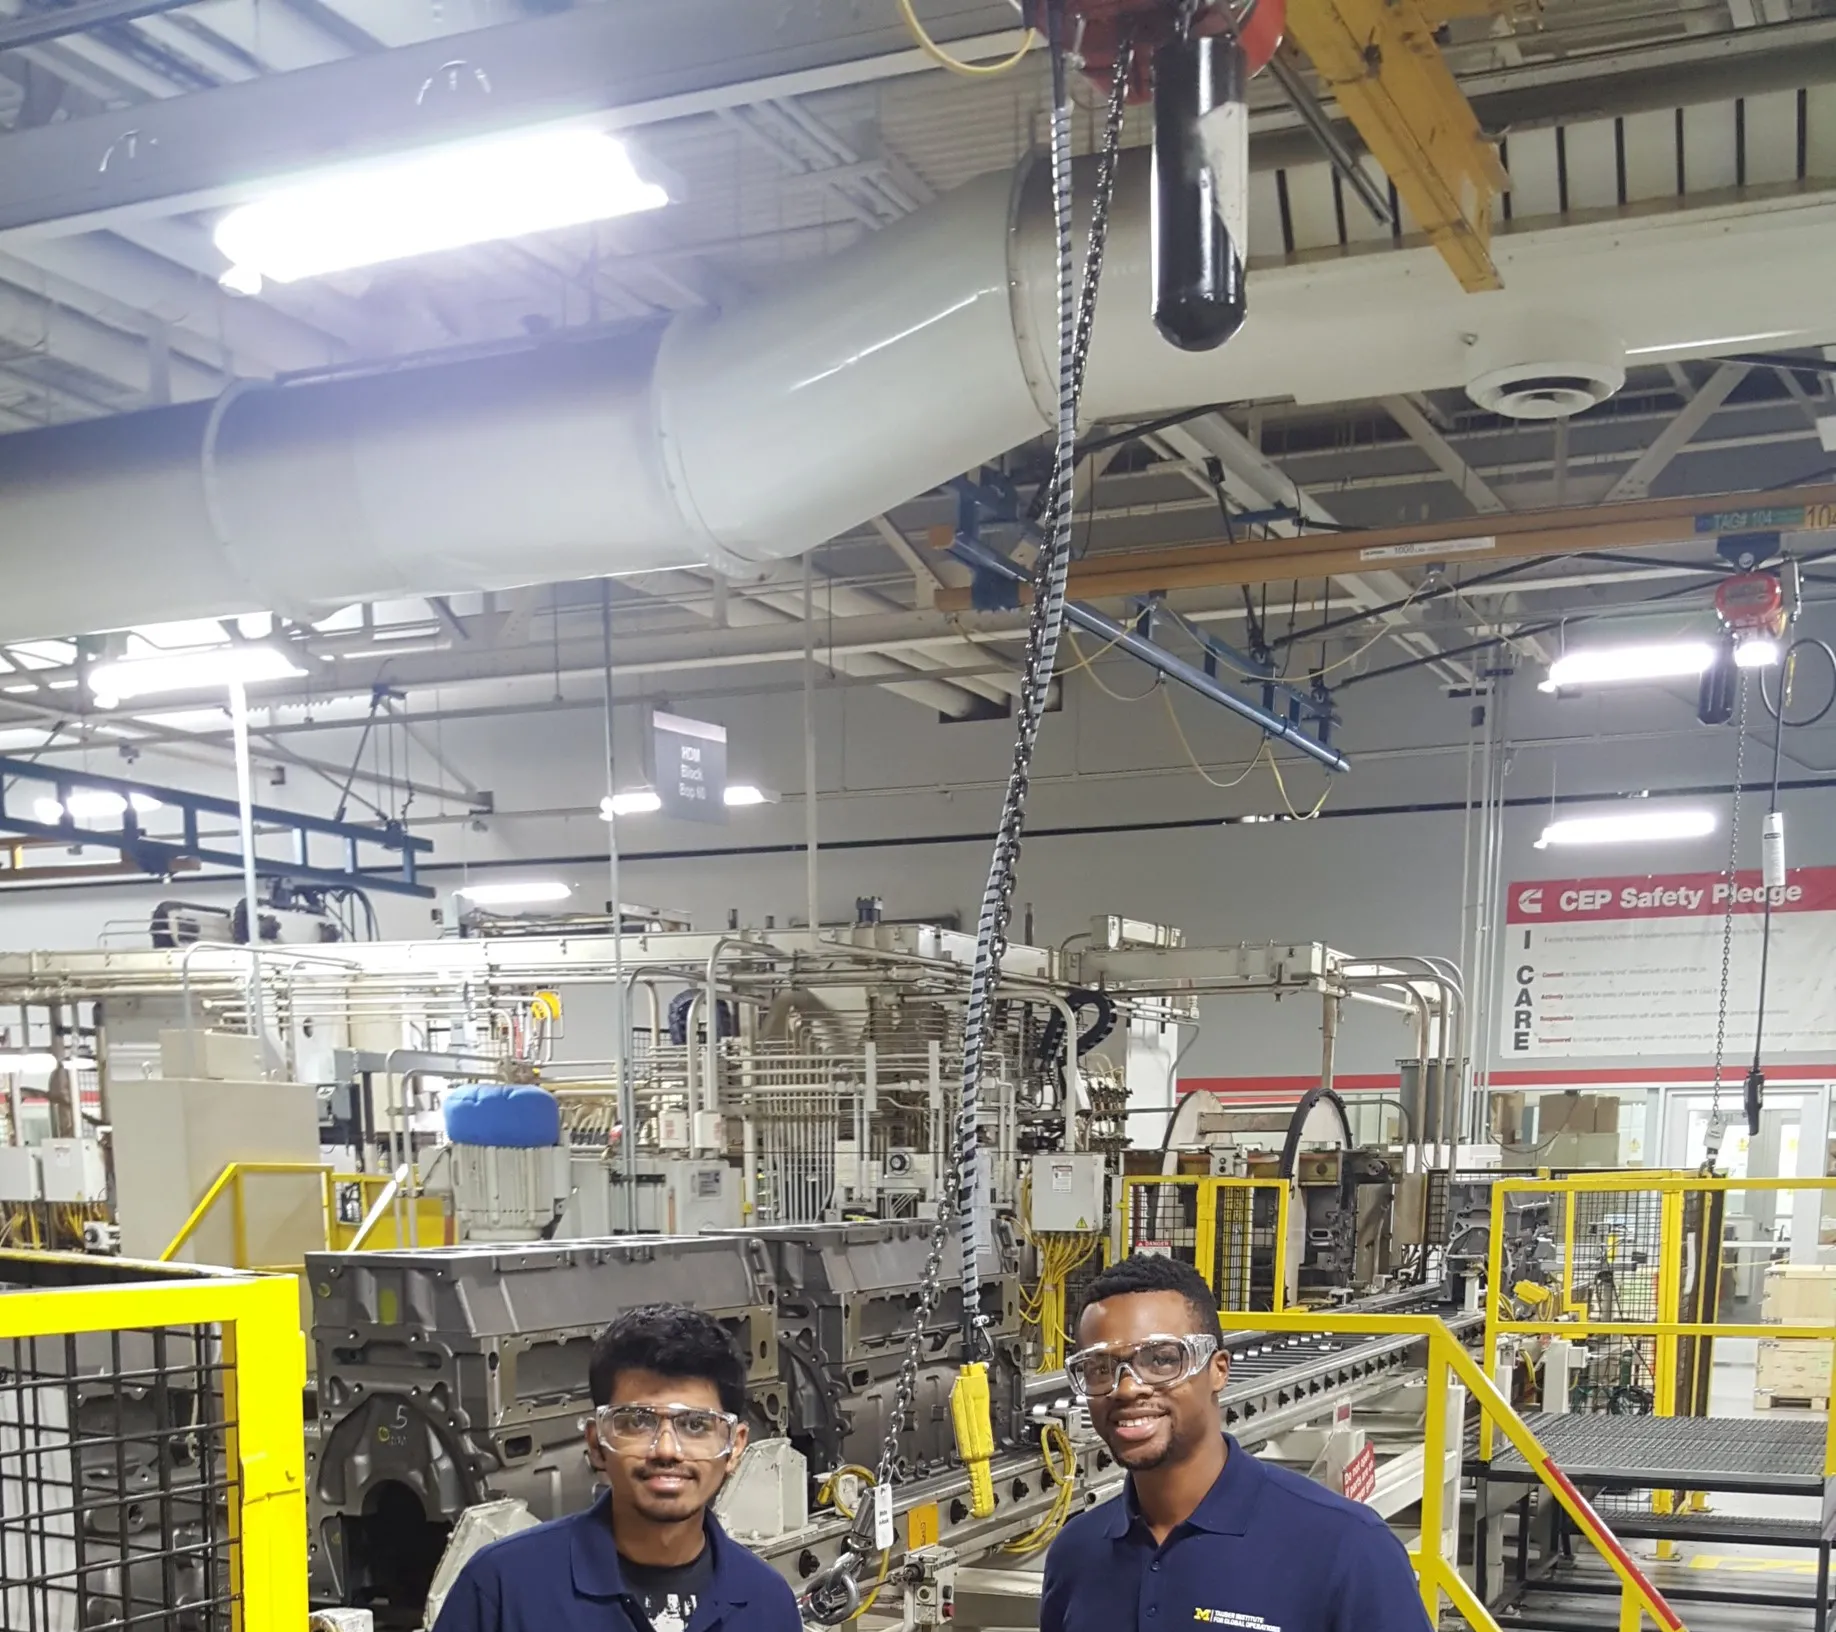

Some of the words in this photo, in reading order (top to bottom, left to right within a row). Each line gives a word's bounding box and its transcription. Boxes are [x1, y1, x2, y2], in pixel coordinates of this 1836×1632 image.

[1559, 889, 1613, 912] CEP
[1619, 886, 1705, 910] Safety
[1711, 883, 1802, 906] Pledge
[390, 1404, 408, 1430] 5
[1193, 1607, 1211, 1621] M
